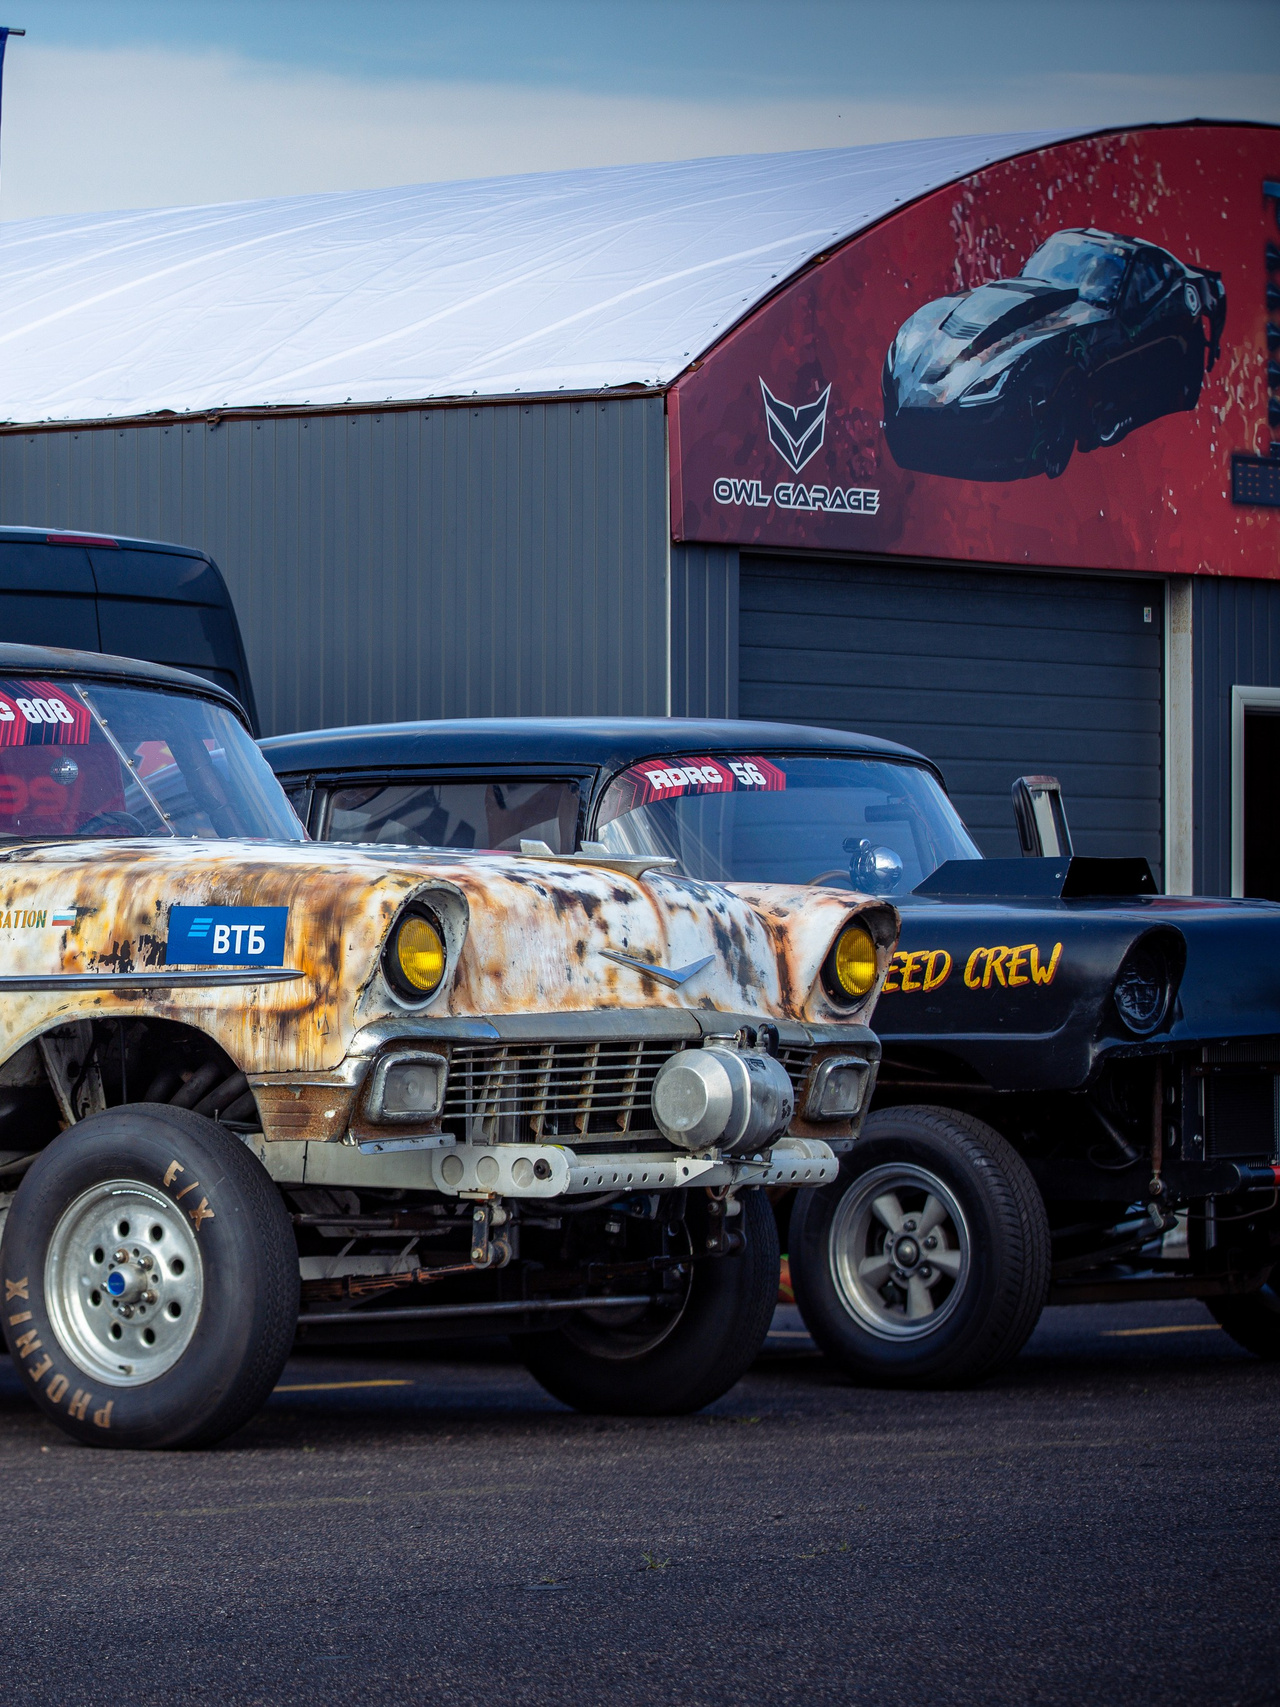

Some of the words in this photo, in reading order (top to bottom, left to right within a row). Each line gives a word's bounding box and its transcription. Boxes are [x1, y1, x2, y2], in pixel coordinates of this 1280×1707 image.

[713, 477, 772, 508] OWL
[774, 482, 881, 515] GARAGE
[15, 698, 75, 724] 808
[644, 766, 723, 791] RDRC
[728, 762, 767, 786] 56
[212, 925, 266, 955] ВТБ
[963, 942, 1064, 990] CREW
[5, 1276, 115, 1429] PHOENIX
